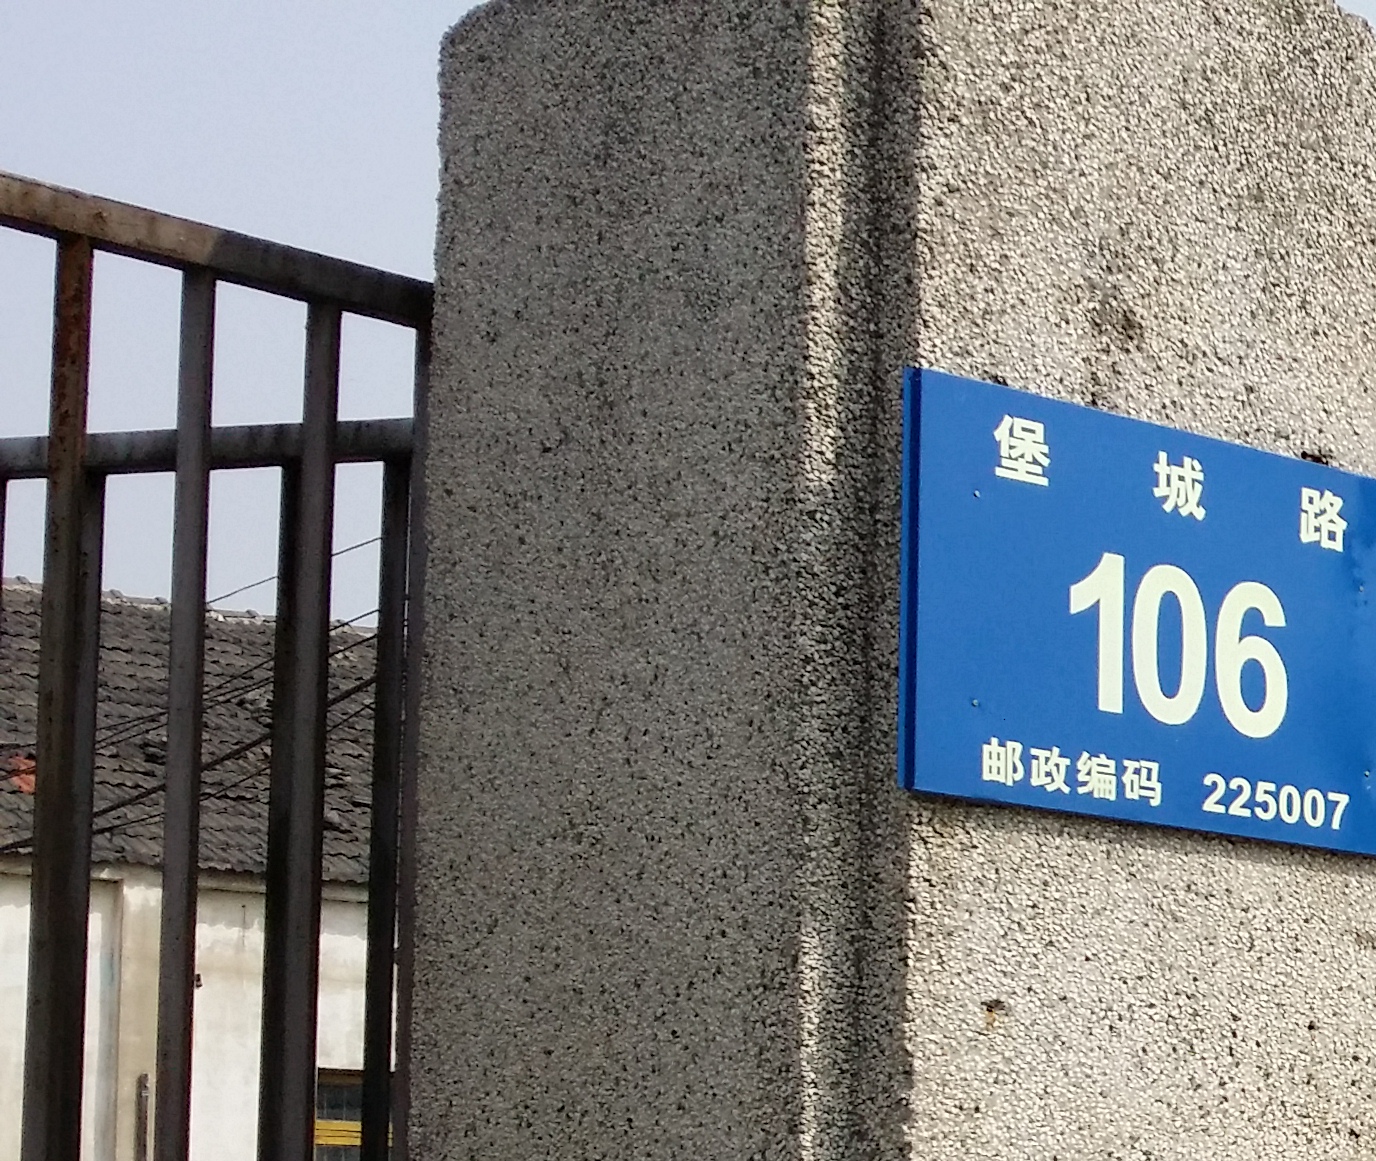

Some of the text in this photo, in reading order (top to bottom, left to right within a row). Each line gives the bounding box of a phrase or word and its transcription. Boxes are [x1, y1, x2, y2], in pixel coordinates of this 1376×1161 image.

[993, 413, 1349, 553] 堡城路
[1069, 551, 1289, 739] 106
[980, 736, 1351, 831] 邮政编码 225007
